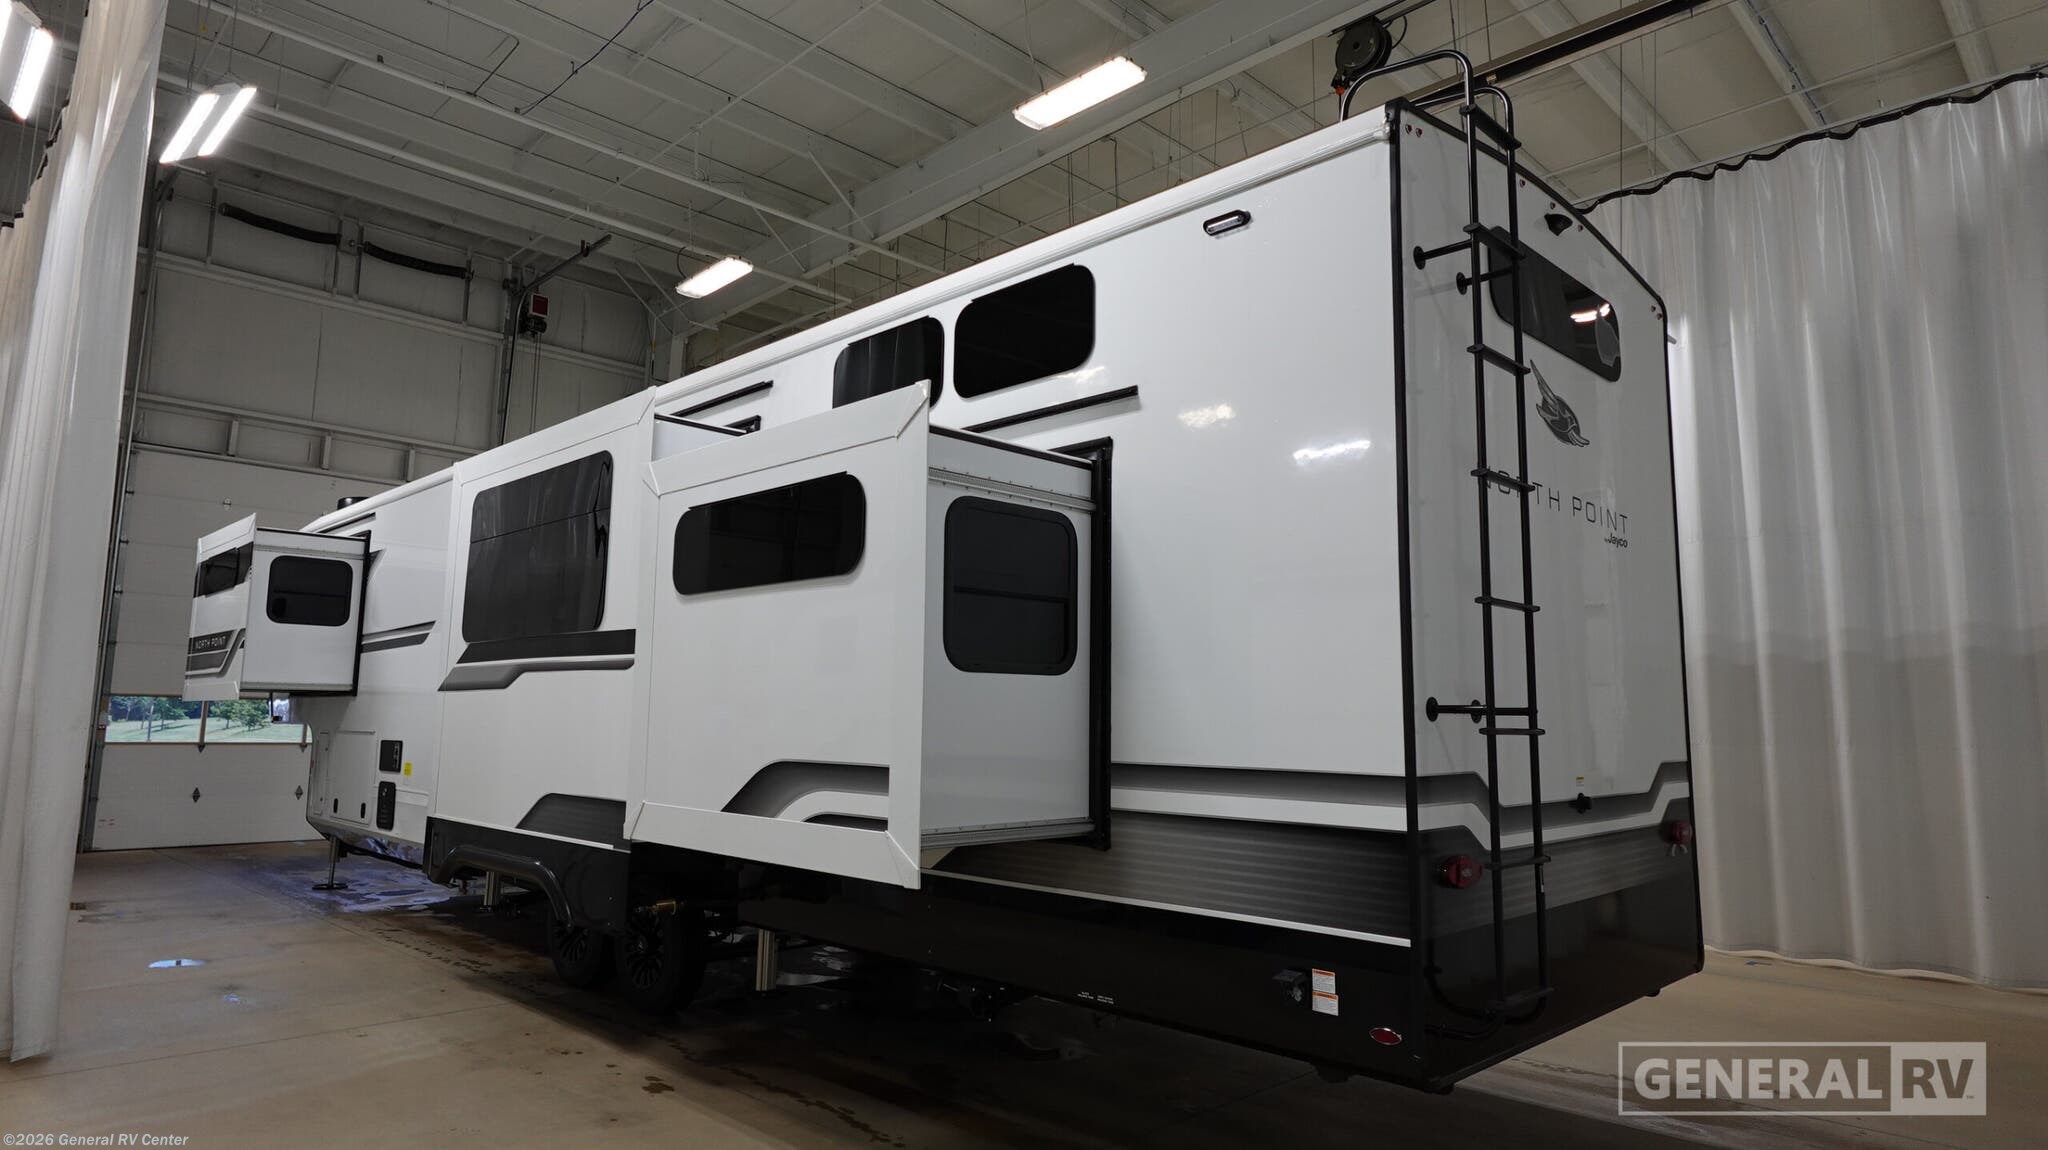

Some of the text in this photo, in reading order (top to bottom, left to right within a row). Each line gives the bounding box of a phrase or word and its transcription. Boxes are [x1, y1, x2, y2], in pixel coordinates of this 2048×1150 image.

[1572, 496, 1628, 534] POINT
[1609, 532, 1628, 548] Jayco
[211, 635, 226, 648] POINT
